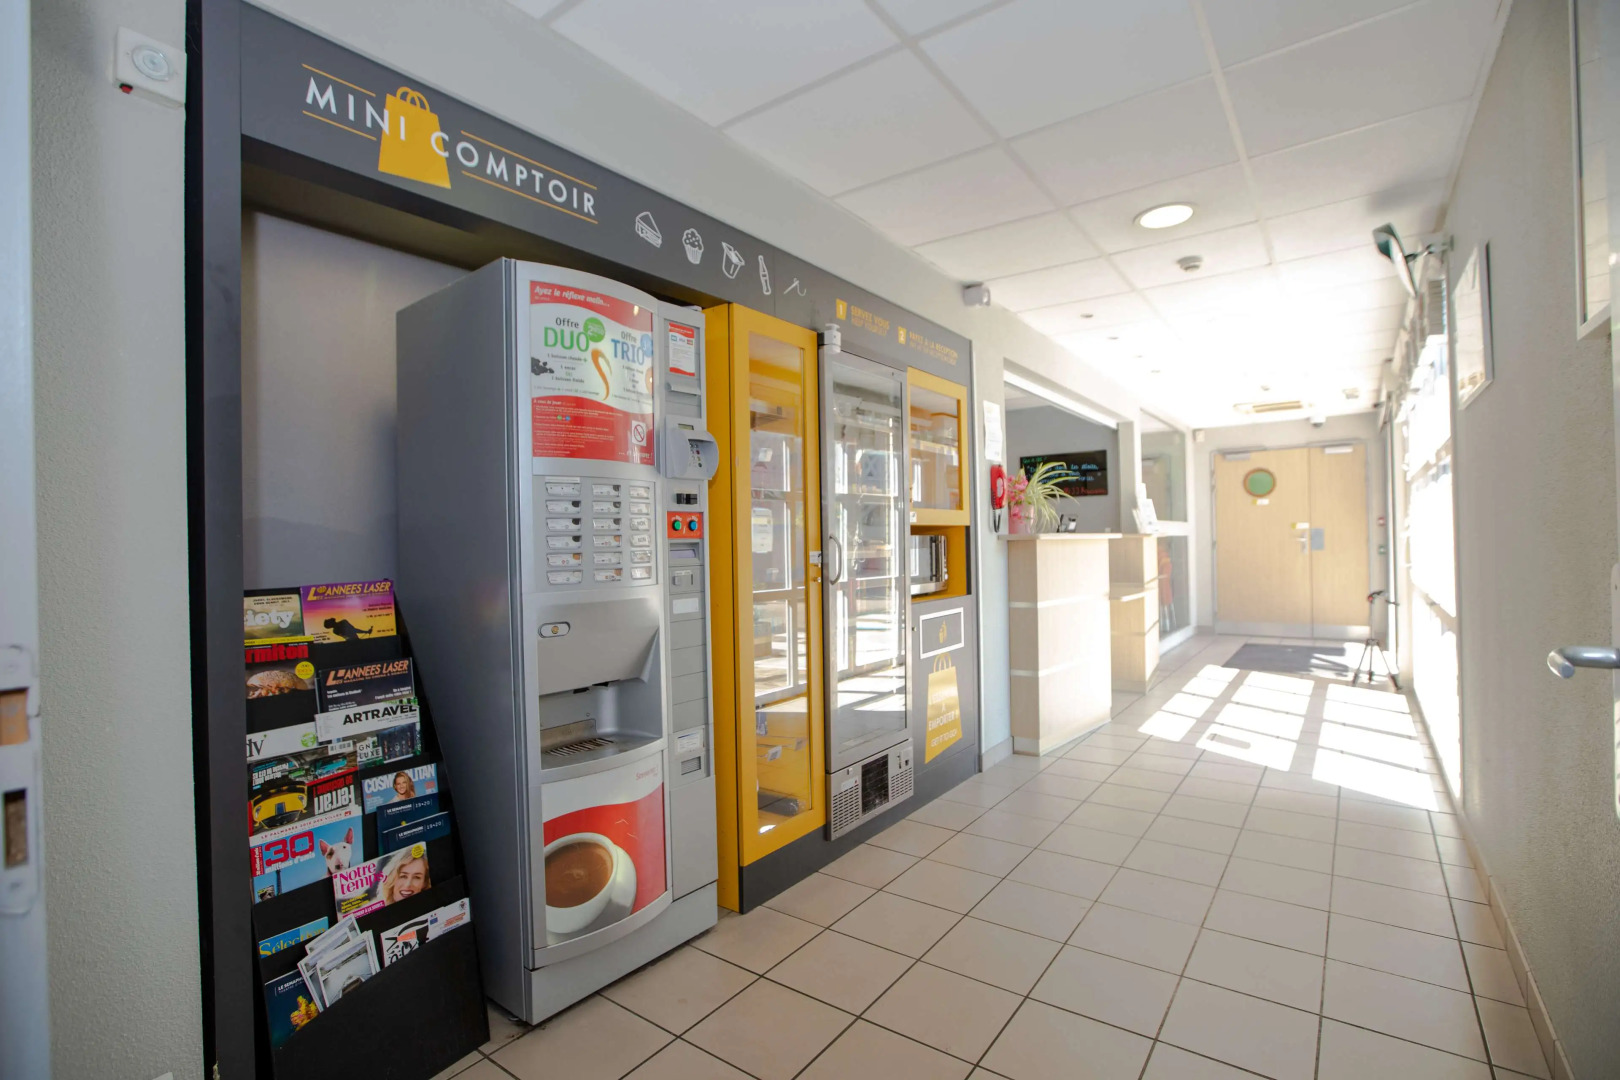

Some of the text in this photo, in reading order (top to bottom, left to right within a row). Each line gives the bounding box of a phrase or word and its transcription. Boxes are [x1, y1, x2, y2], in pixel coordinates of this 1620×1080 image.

[305, 76, 596, 217] MINI COMPTOIR
[534, 285, 552, 296] Ayez
[553, 288, 561, 297] le
[562, 290, 585, 301] réflexe
[555, 316, 580, 329] Offre
[543, 326, 590, 352] DUO
[620, 330, 637, 344] Offre
[610, 338, 645, 366] TRIO
[364, 581, 391, 593] LASER
[244, 609, 294, 628] iety
[382, 660, 409, 674] LASER
[342, 704, 417, 726] ARTRAVEL
[928, 710, 955, 732] EMPORTER
[359, 748, 380, 760] LUXE
[264, 830, 315, 867] 30
[339, 862, 377, 882] Notre
